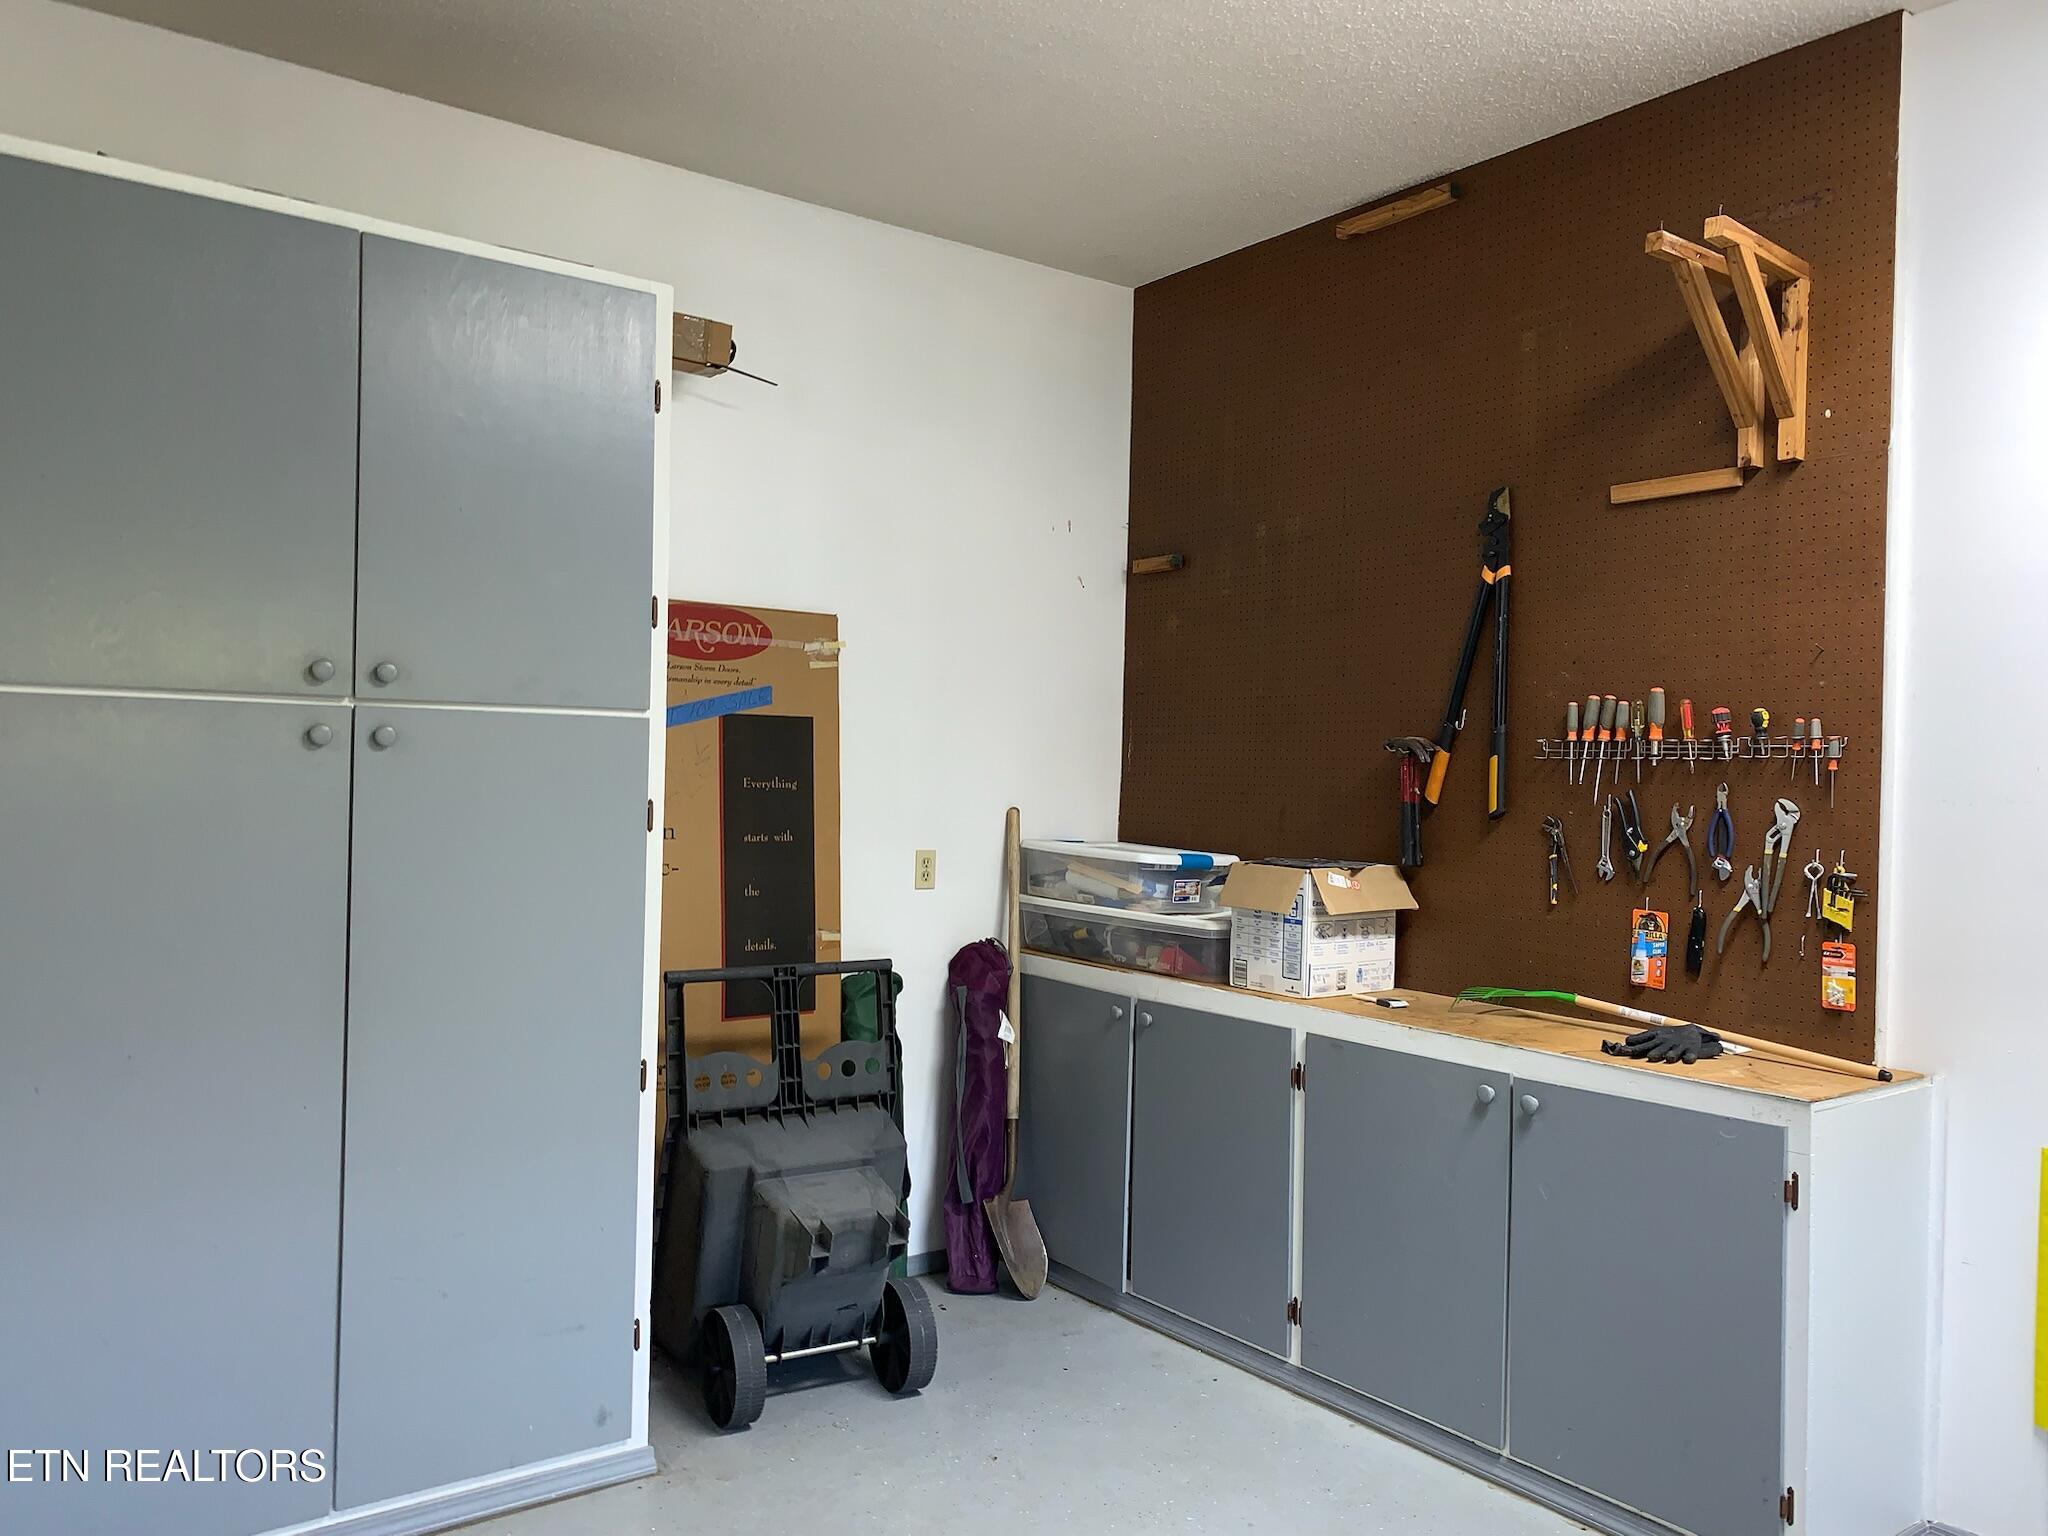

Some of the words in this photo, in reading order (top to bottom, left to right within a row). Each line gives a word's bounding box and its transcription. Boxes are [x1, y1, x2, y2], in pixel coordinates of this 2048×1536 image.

[668, 618, 763, 653] ARSON
[694, 662, 716, 672] Storm
[713, 678, 732, 687] every
[743, 777, 798, 791] Everything
[743, 832, 769, 843] starts
[773, 830, 793, 842] with
[744, 884, 760, 897] the
[745, 939, 777, 951] details.
